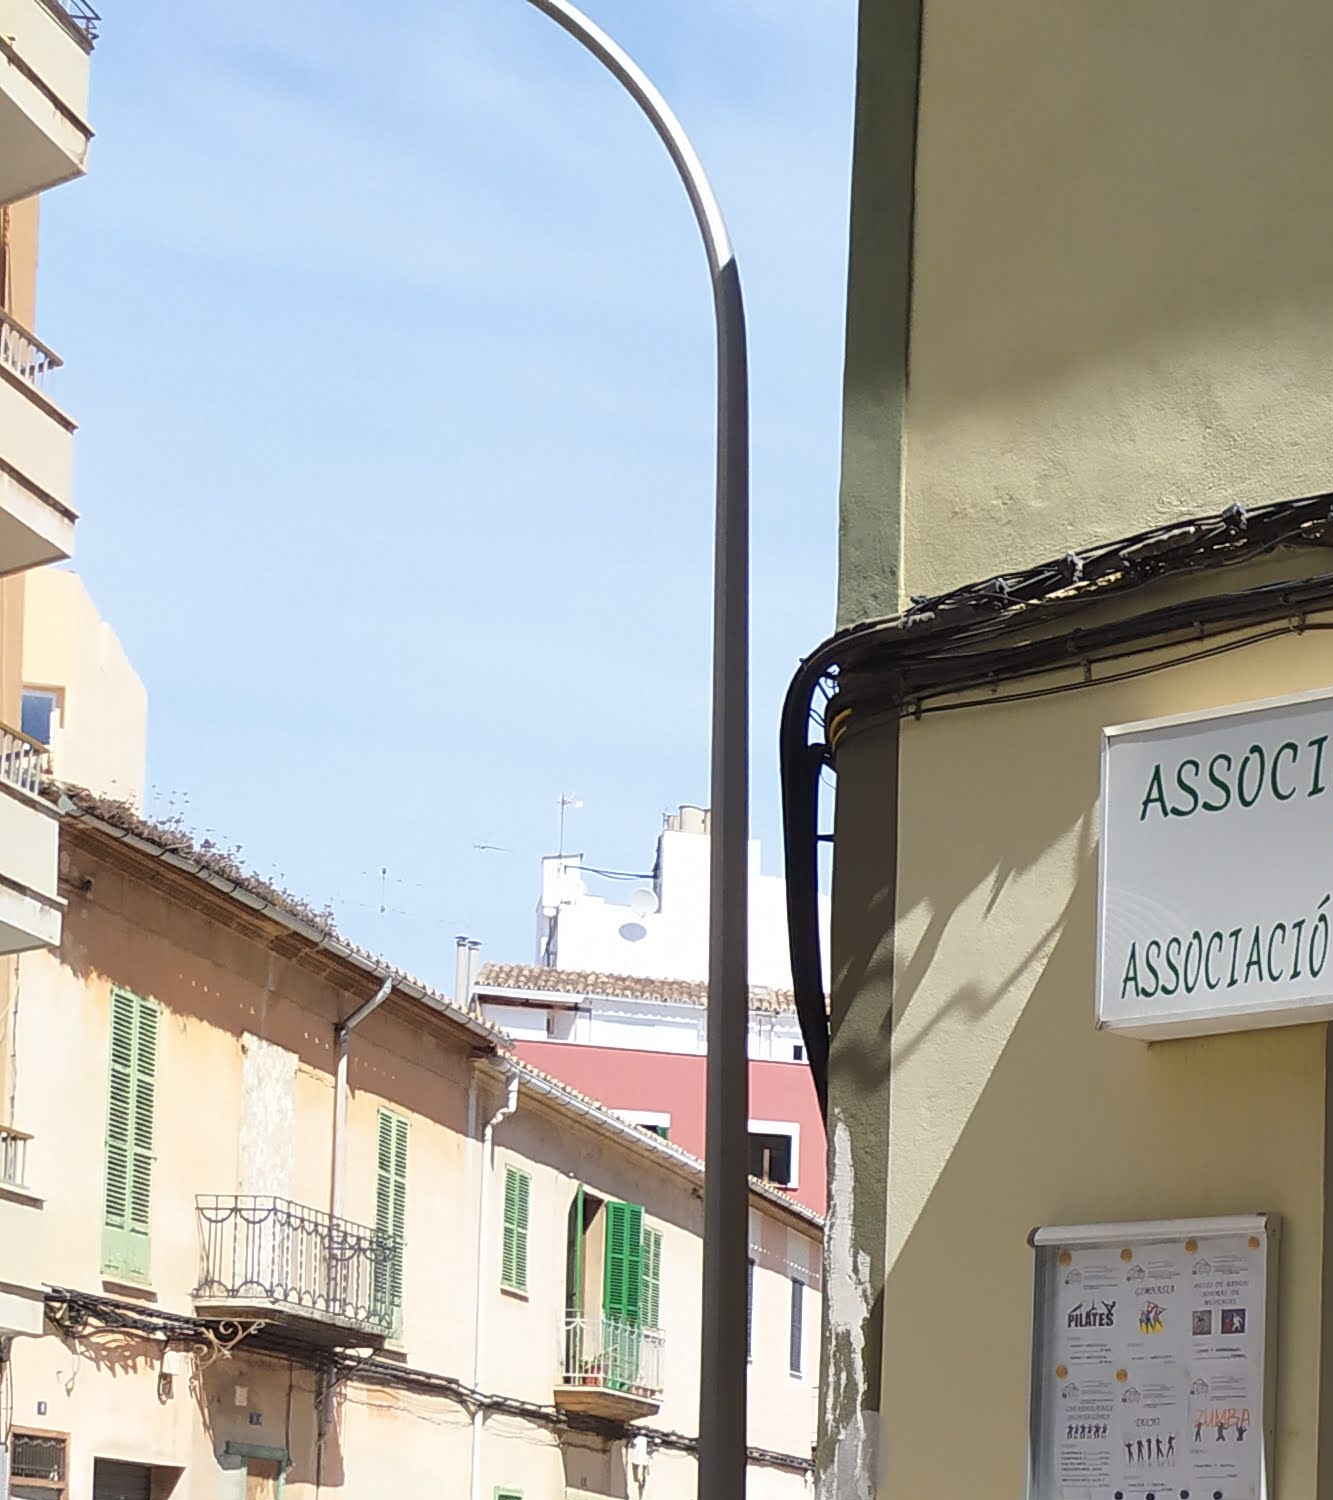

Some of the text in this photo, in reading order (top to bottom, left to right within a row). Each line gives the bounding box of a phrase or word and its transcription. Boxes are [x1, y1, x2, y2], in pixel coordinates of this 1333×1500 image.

[1121, 895, 1331, 1000] ASSOCIACIÓ
[1067, 1312, 1114, 1329] PILATES
[1194, 1407, 1250, 1427] ZUMBA
